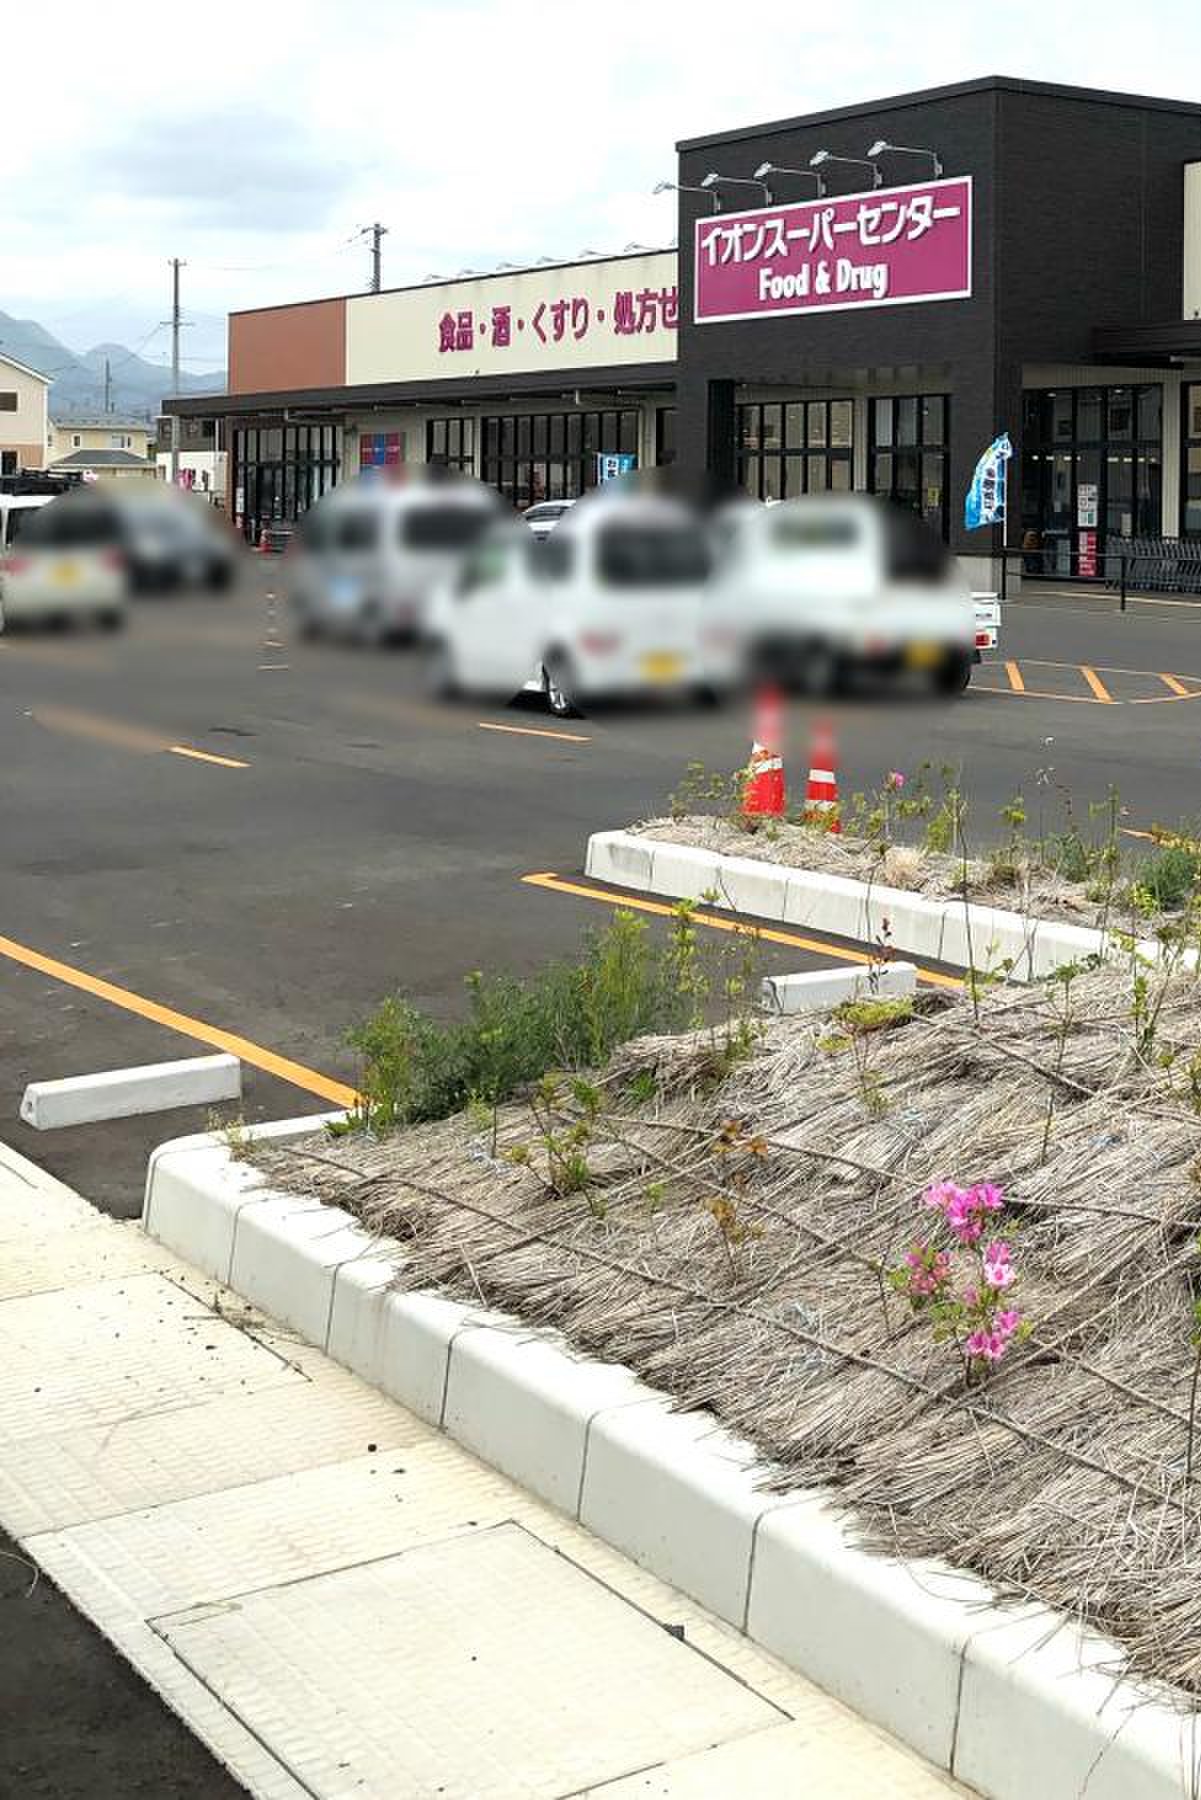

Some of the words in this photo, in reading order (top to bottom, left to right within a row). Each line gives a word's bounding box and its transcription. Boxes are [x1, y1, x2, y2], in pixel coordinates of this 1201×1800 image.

[701, 196, 961, 266] イオンスーパーセンター
[758, 264, 811, 300] Food
[815, 259, 831, 295] &
[836, 258, 889, 299] Drug
